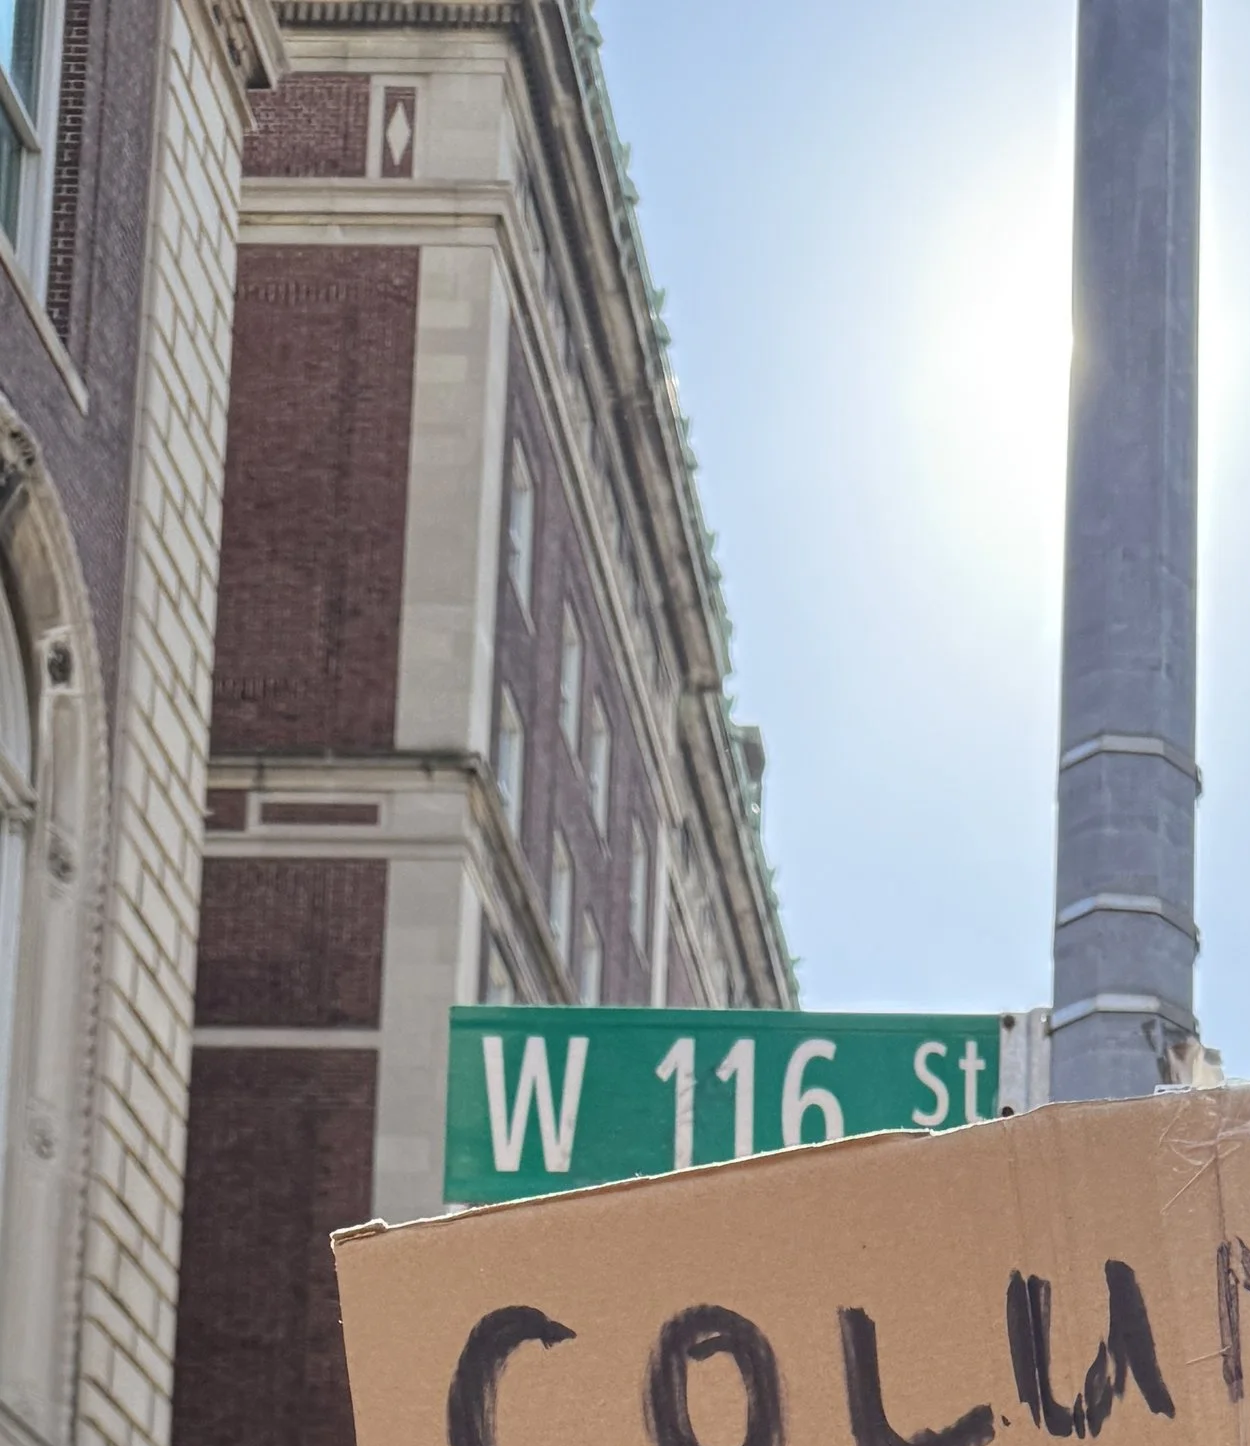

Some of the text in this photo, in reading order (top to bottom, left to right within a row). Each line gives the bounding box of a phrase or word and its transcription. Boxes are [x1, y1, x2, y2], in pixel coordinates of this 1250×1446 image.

[482, 1035, 987, 1173] W 116 St
